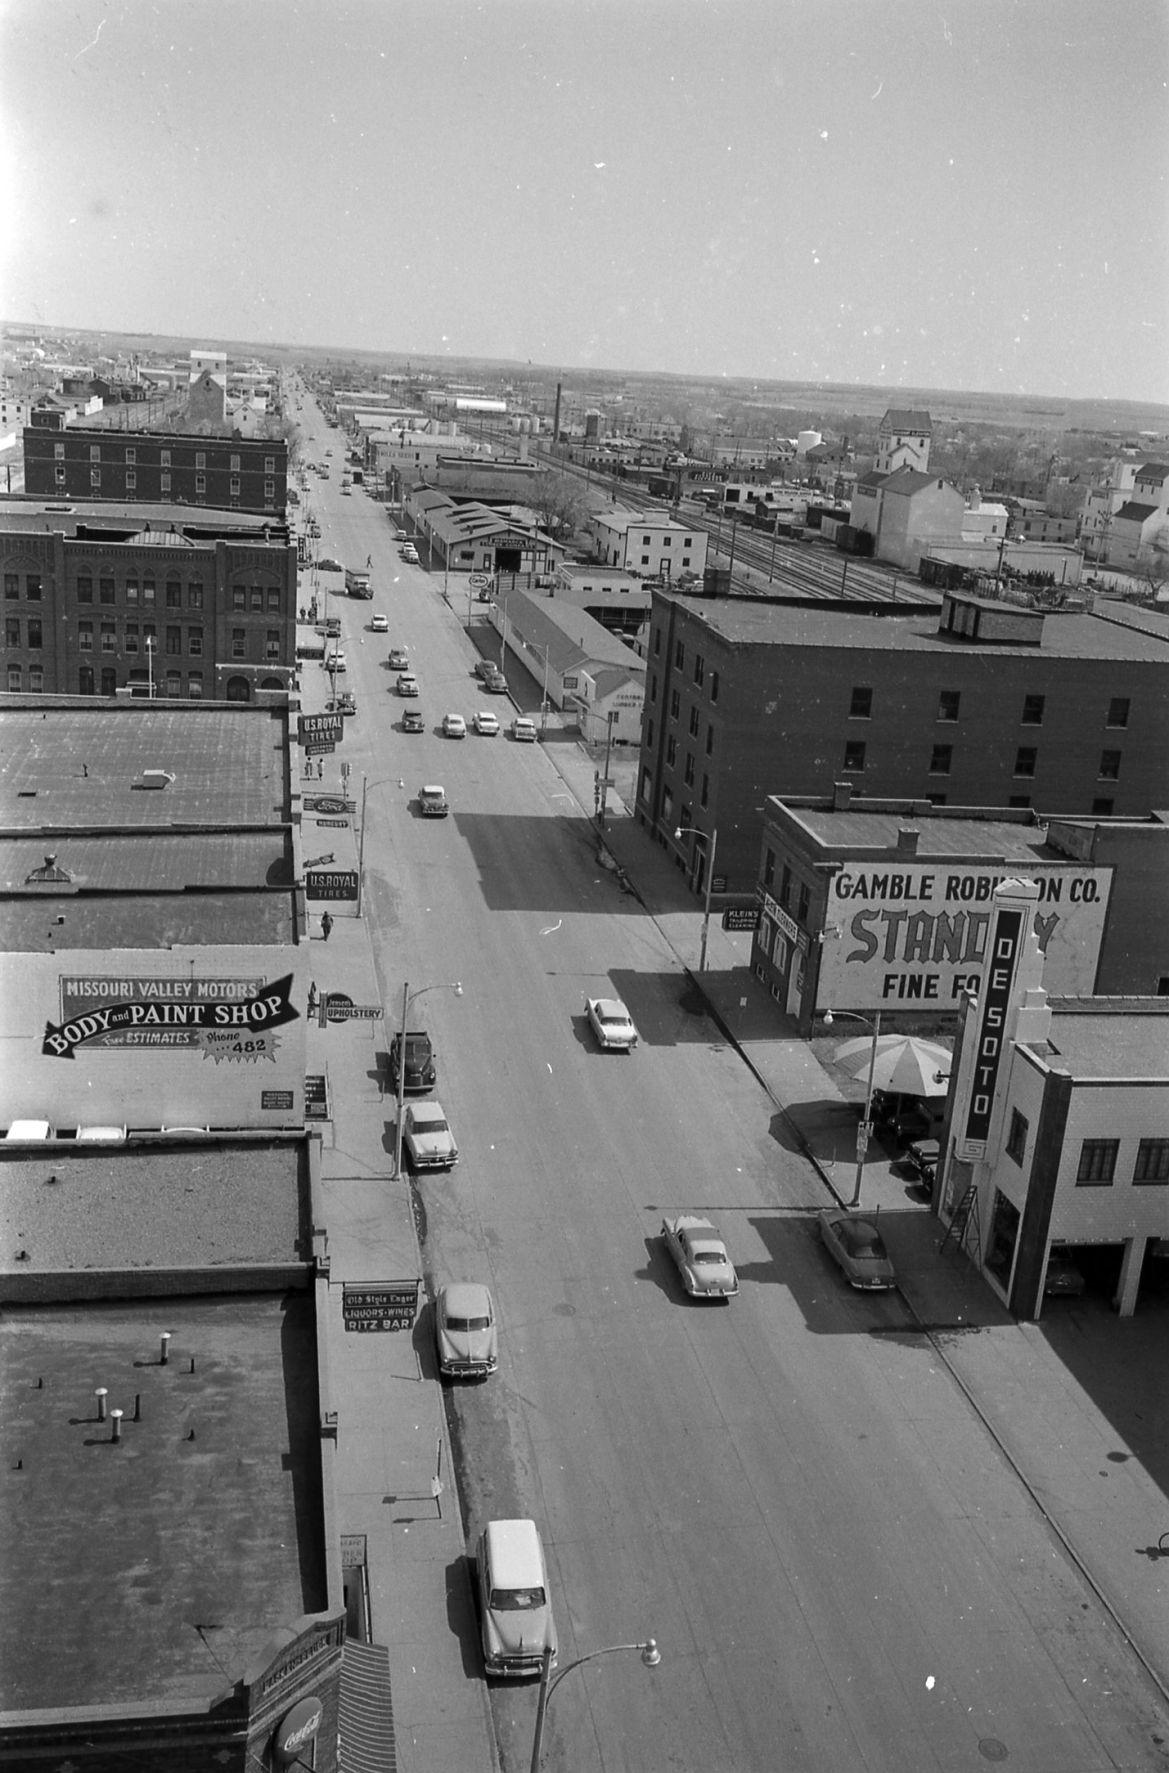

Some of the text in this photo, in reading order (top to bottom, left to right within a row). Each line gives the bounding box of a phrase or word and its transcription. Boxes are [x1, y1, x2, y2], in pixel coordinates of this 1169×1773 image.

[310, 731, 336, 741] TIRES
[317, 800, 345, 812] Ford
[318, 889, 347, 898] TIRES
[835, 873, 935, 899] GAMBLE
[1069, 878, 1101, 903] CO.
[66, 981, 258, 998] MISSOURI VALLEY MOTORS
[882, 974, 940, 998] FINE
[327, 1008, 381, 1018] UPHOLSTERY
[45, 995, 282, 1055] BODY and PAINT SHOP
[125, 1032, 191, 1044] ESTIMATES
[206, 1032, 240, 1044] Phone
[348, 1318, 410, 1331] RITZ BAR
